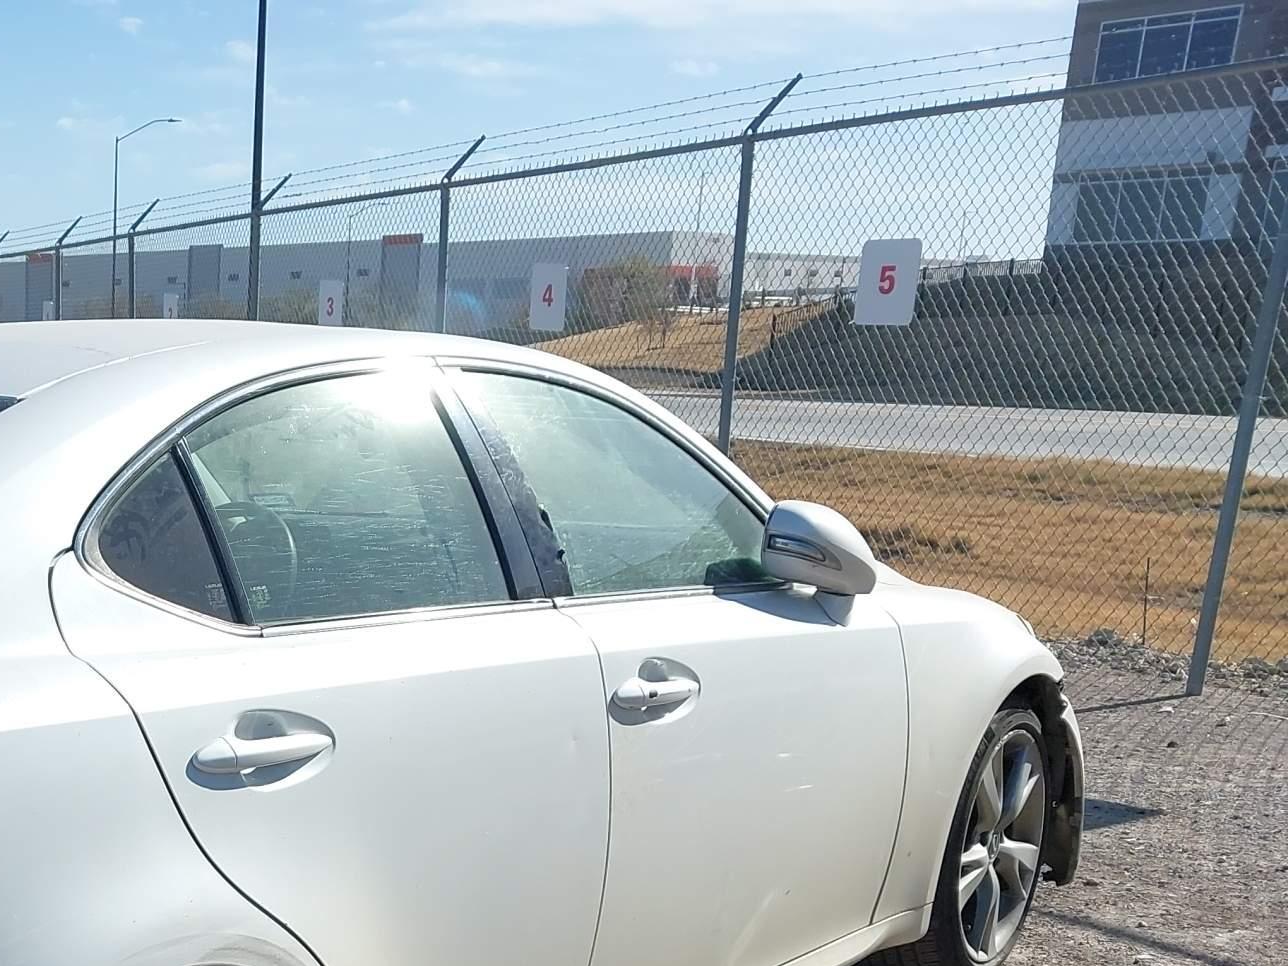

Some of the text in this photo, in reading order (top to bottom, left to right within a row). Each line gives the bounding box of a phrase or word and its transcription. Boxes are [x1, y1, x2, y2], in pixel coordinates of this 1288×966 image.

[878, 265, 897, 295] 5
[326, 296, 335, 316] 3
[542, 284, 554, 307] 4
